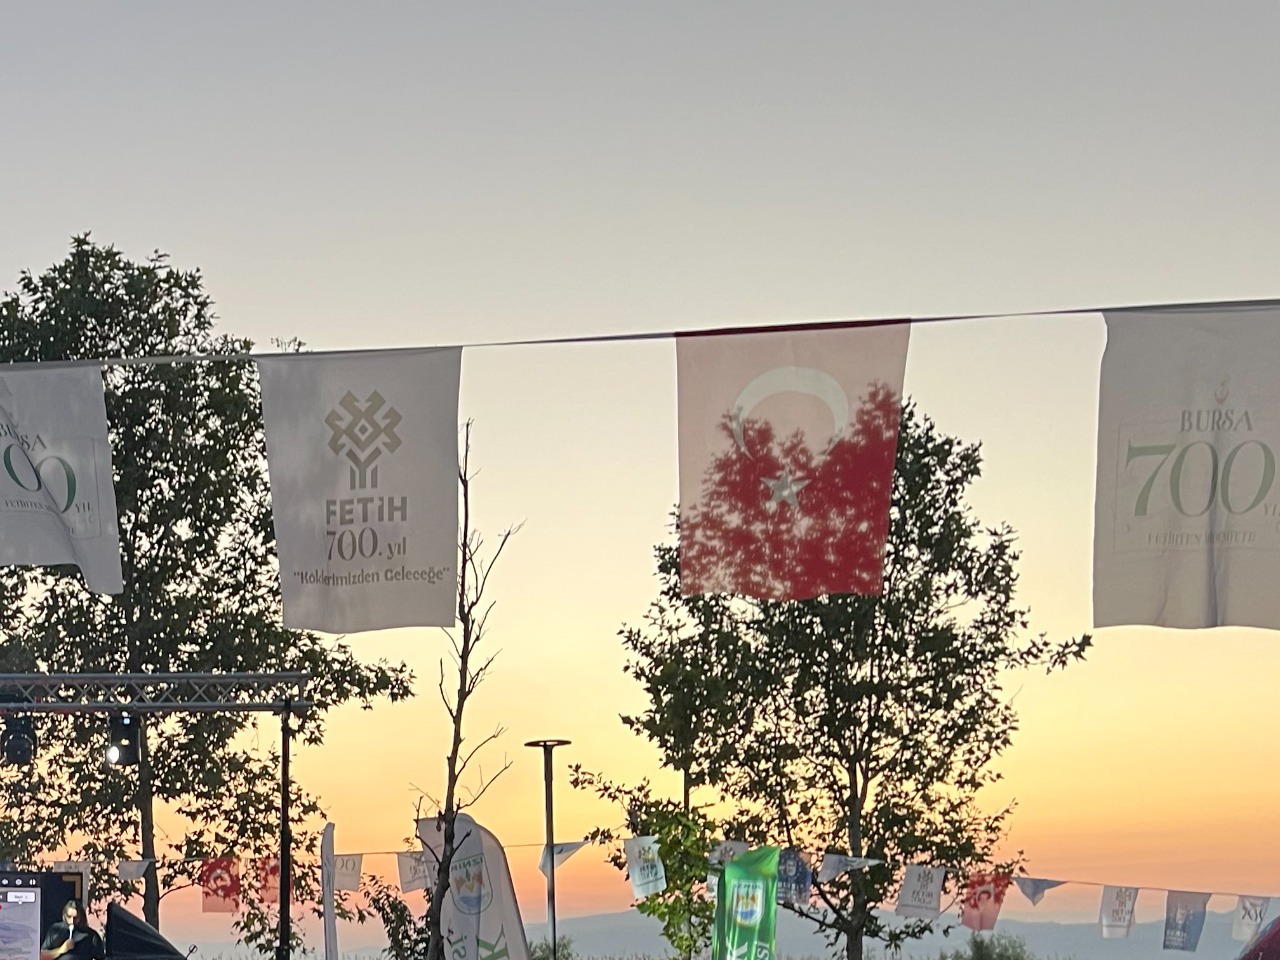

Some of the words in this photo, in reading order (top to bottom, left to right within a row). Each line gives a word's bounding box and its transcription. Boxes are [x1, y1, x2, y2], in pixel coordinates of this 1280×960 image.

[1180, 408, 1254, 433] BURSA
[1125, 438, 1276, 518] 700
[326, 495, 408, 526] FETİH
[386, 537, 407, 560] yıl
